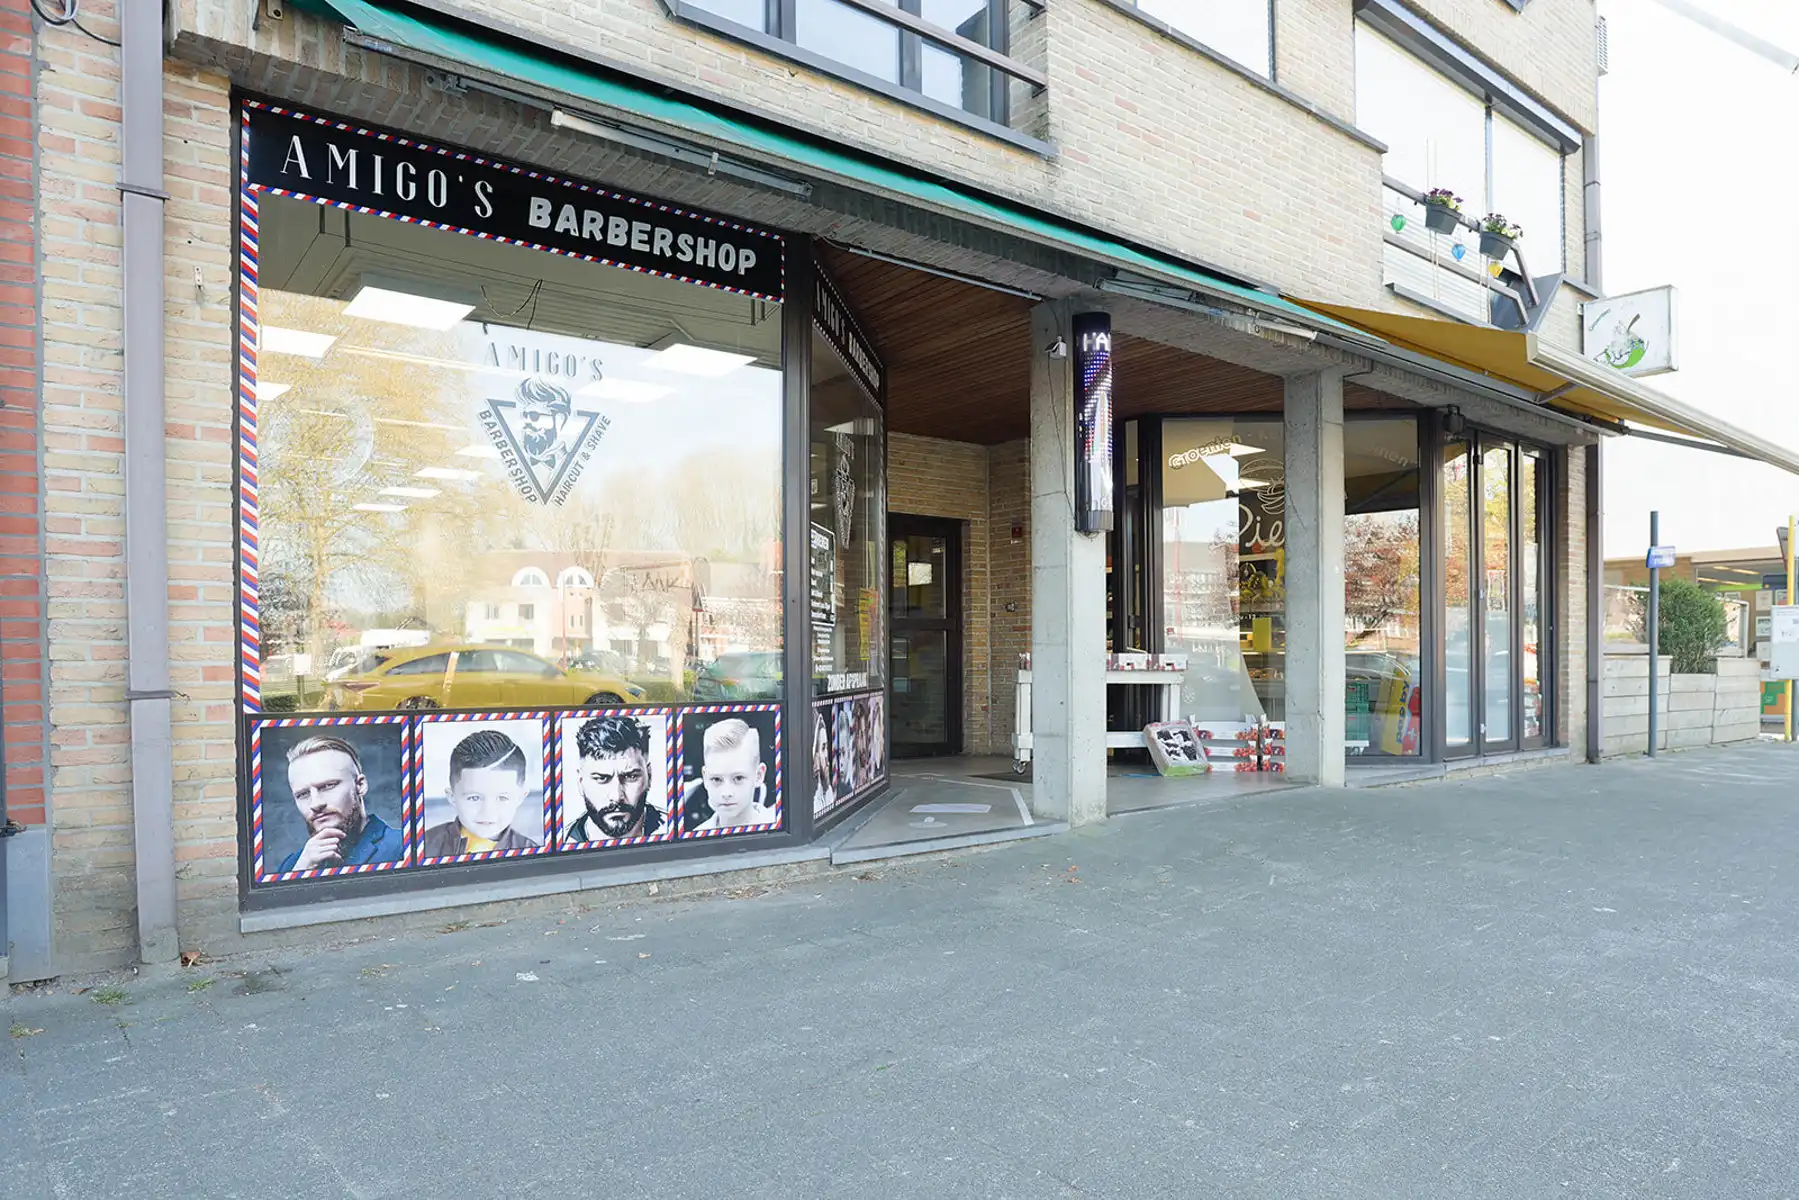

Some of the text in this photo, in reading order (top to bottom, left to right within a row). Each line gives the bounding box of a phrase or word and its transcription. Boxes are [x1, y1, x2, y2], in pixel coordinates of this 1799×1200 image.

[281, 134, 757, 276] AMIGO'S BARBERSHOP
[485, 342, 604, 382] AMIGO'S
[479, 410, 538, 504] BARBERSHOP
[554, 462, 585, 506] HAIRCUT
[587, 415, 612, 452] SHAVE
